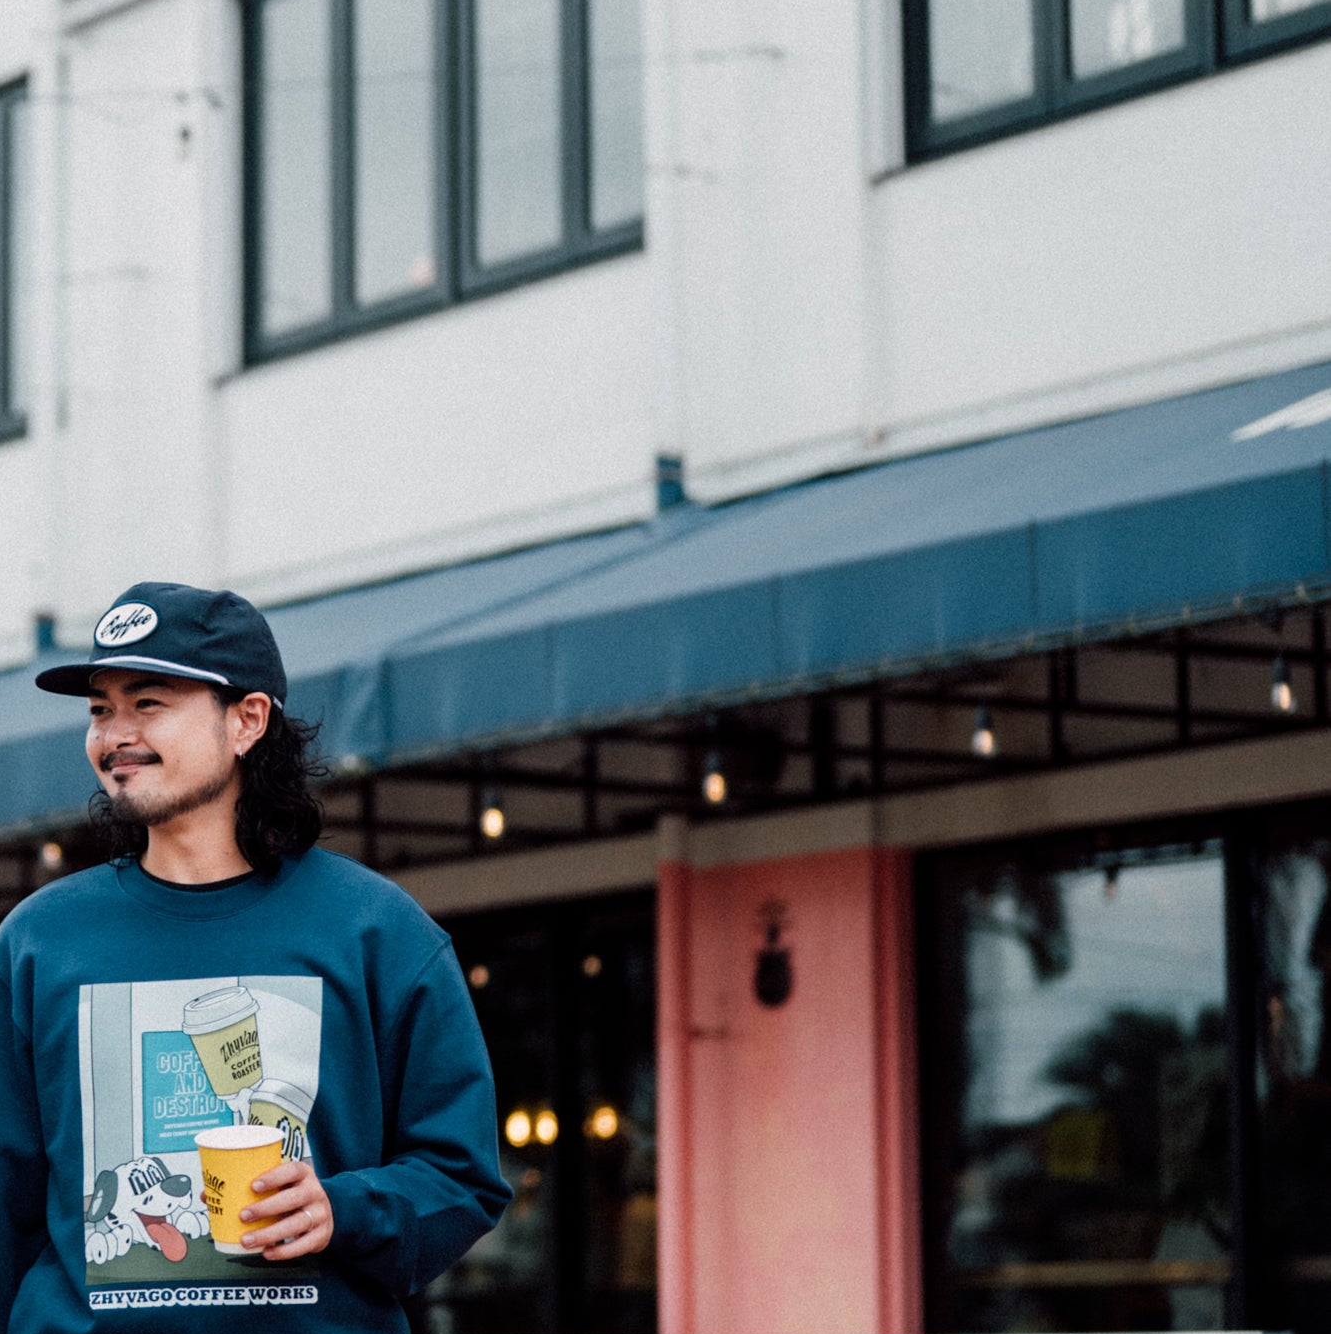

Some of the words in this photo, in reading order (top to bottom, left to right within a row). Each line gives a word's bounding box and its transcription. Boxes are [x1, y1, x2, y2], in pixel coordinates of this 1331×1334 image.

[100, 607, 152, 641] Coffee
[219, 1030, 258, 1064] Zhyvag
[156, 1050, 202, 1074] COFF
[231, 1061, 261, 1080] ROASTER
[174, 1072, 207, 1094] AND
[90, 1289, 171, 1306] ZHYVAGO
[175, 1288, 250, 1302] COFFEE
[250, 1287, 315, 1301] WORKS
